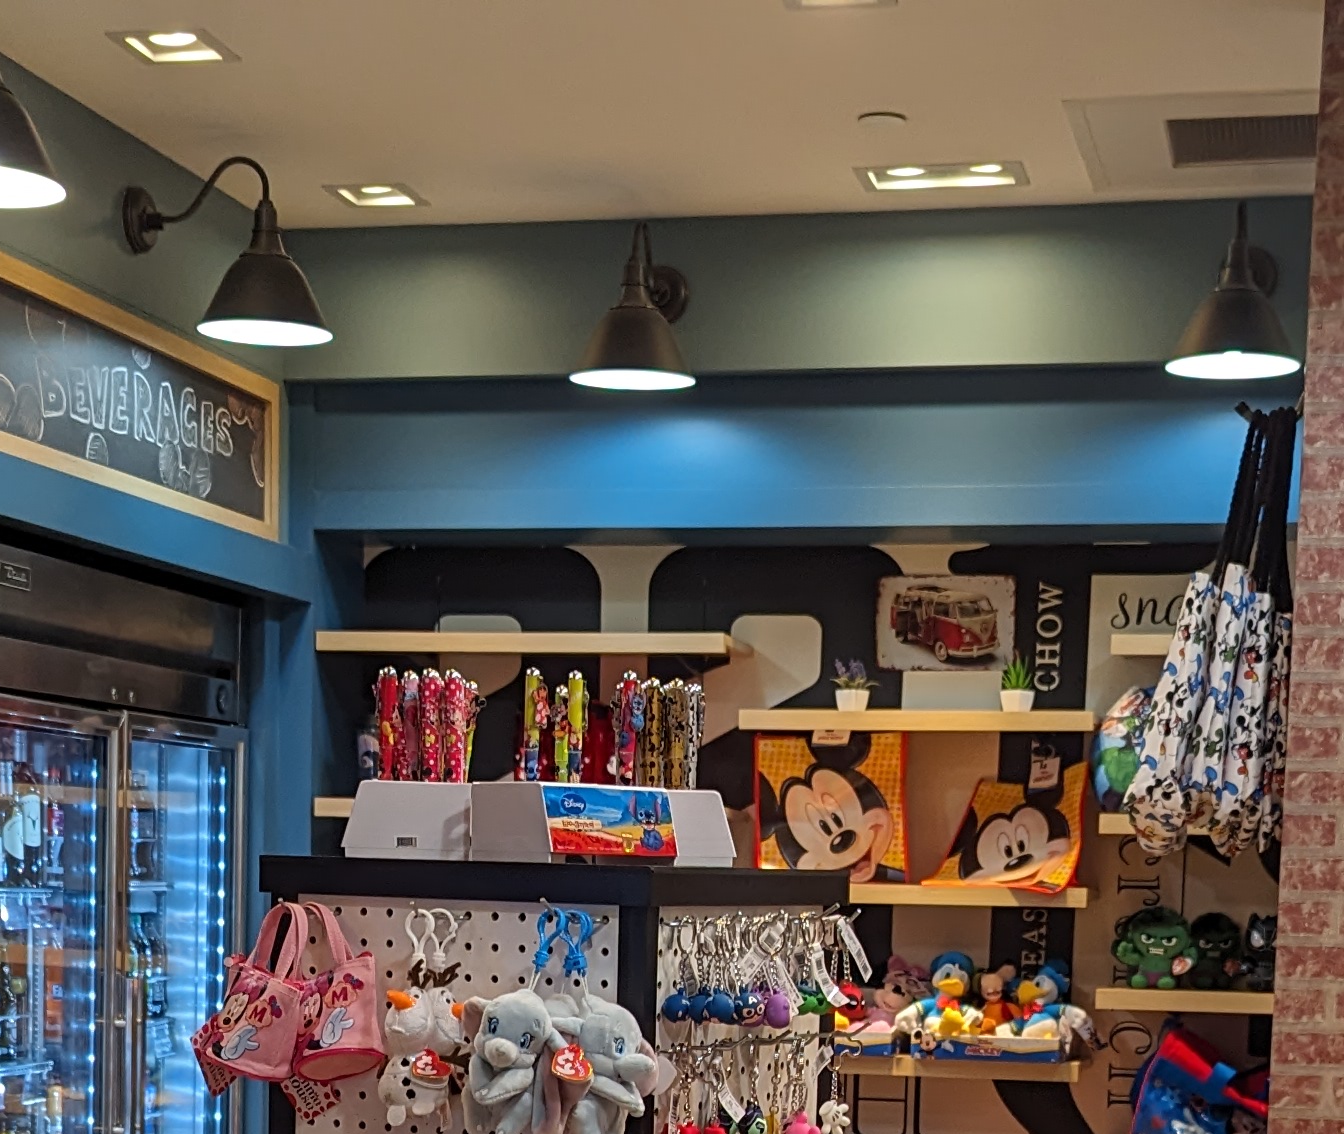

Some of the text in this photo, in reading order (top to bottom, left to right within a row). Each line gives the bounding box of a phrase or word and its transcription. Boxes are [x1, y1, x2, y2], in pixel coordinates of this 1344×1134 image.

[40, 357, 235, 457] BEVERAGES
[1034, 581, 1064, 692] CHOW
[248, 1007, 268, 1023] M
[331, 986, 349, 1004] M
